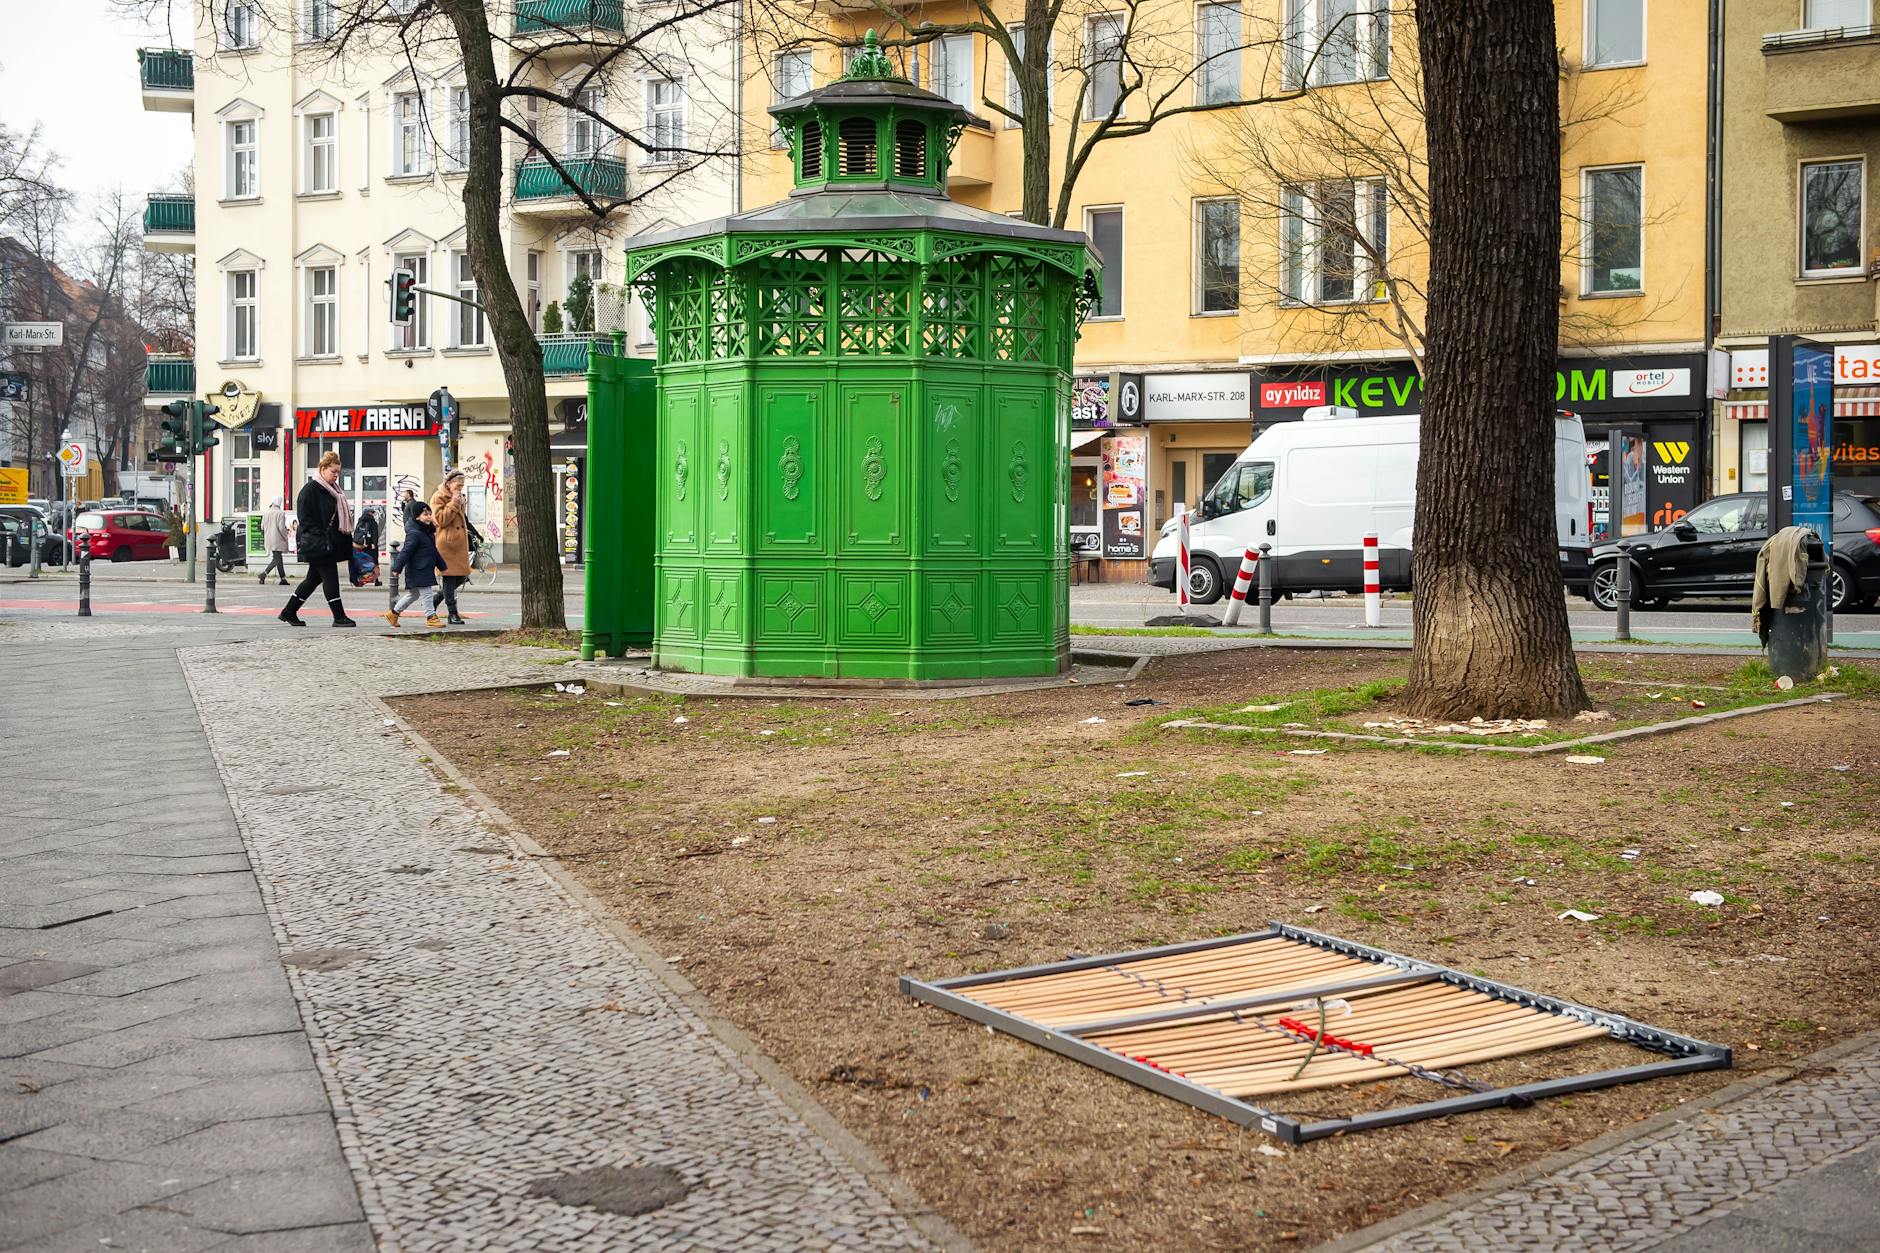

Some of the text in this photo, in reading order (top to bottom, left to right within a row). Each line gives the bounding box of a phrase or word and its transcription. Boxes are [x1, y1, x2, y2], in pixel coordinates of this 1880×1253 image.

[9, 328, 57, 339] Karl-Marx-Str.
[1636, 371, 1665, 381] ortel
[1334, 369, 1606, 408] KEV M
[1149, 391, 1246, 402] KARL-MARX-STR. 208
[1266, 389, 1282, 405] ay
[1071, 403, 1098, 420] ast
[257, 431, 274, 446] sky
[1653, 465, 1690, 475] Western
[1658, 475, 1685, 484] Union
